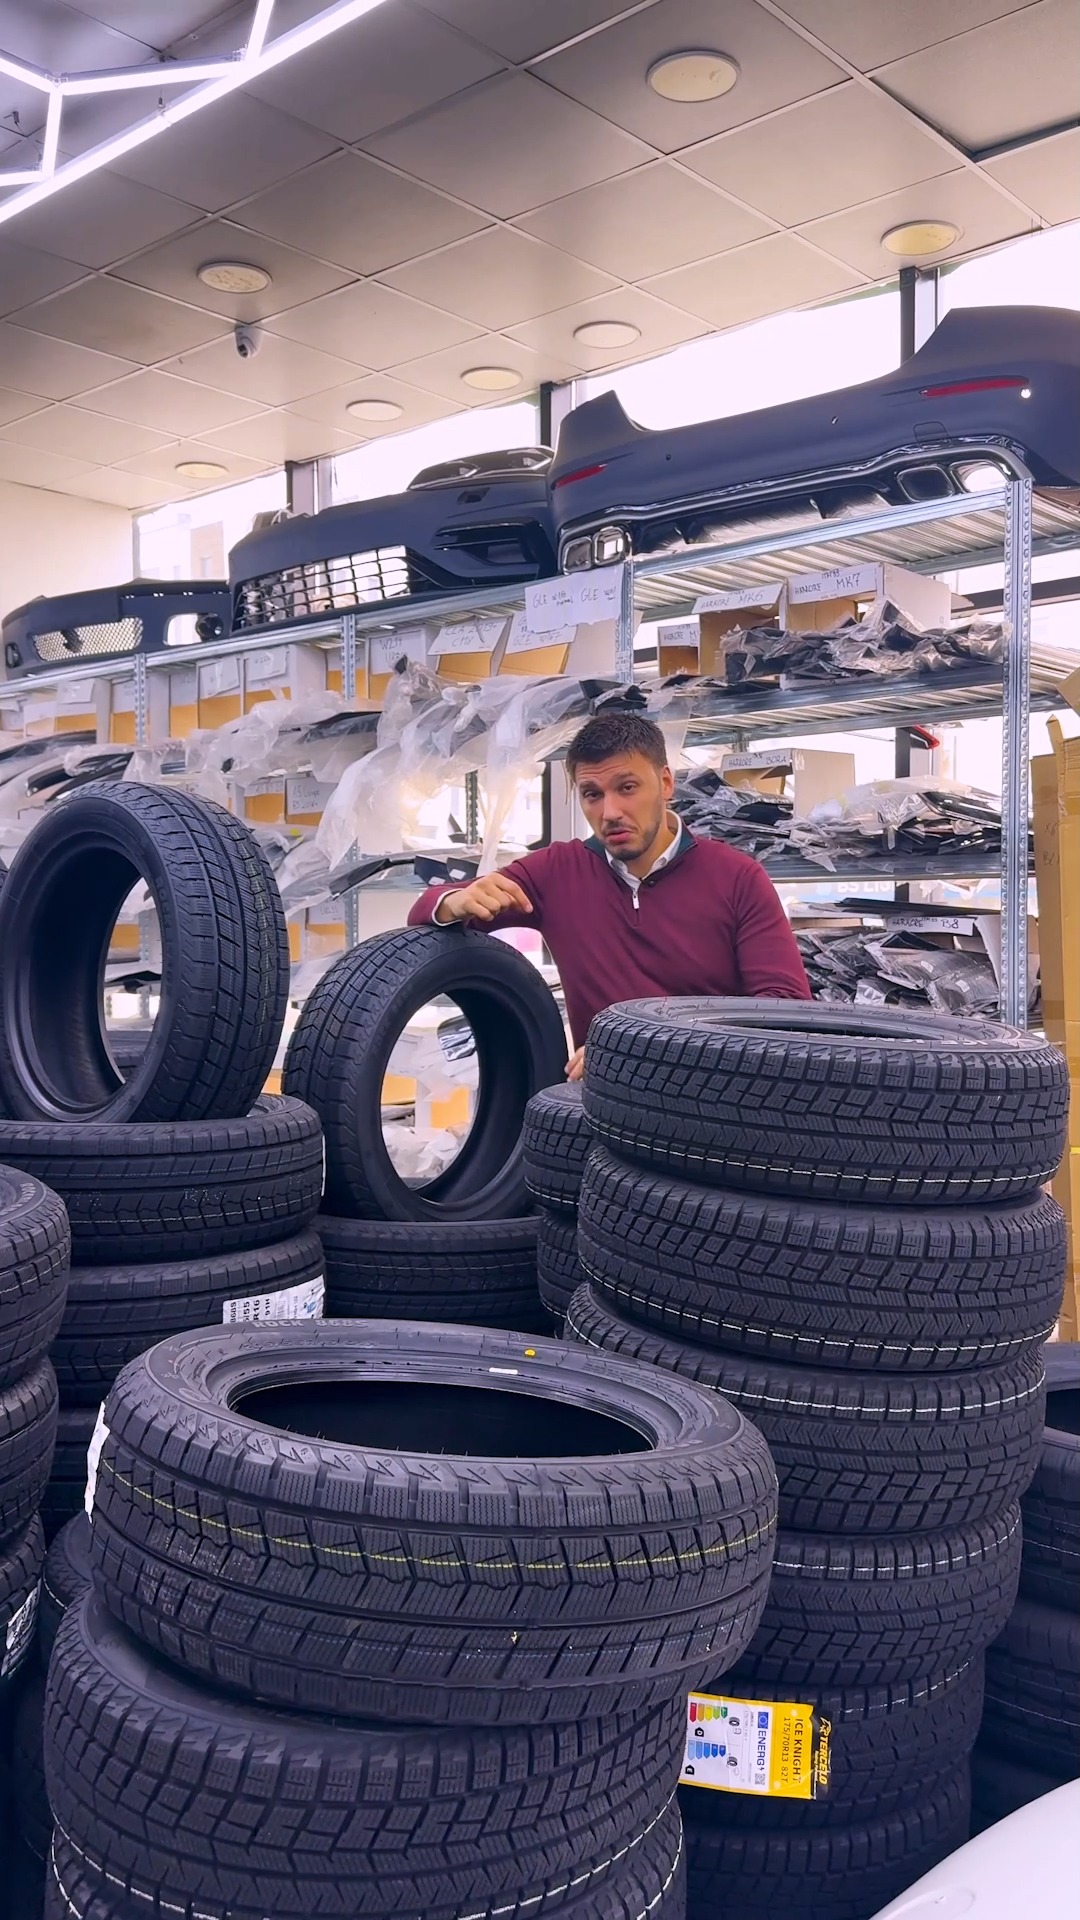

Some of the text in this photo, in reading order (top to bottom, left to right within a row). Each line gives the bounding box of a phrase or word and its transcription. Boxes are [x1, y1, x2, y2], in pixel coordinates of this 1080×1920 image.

[835, 572, 861, 590] MK7
[533, 594, 548, 608] GLE
[581, 588, 599, 602] GLE
[737, 589, 765, 604] MK6
[253, 1299, 261, 1321] R16
[252, 1319, 305, 1329] ROCK
[780, 1717, 791, 1784] 175/70R13 82T
[791, 1718, 804, 1784] ICE KNIGHT
[818, 1736, 829, 1785] TERCELO
